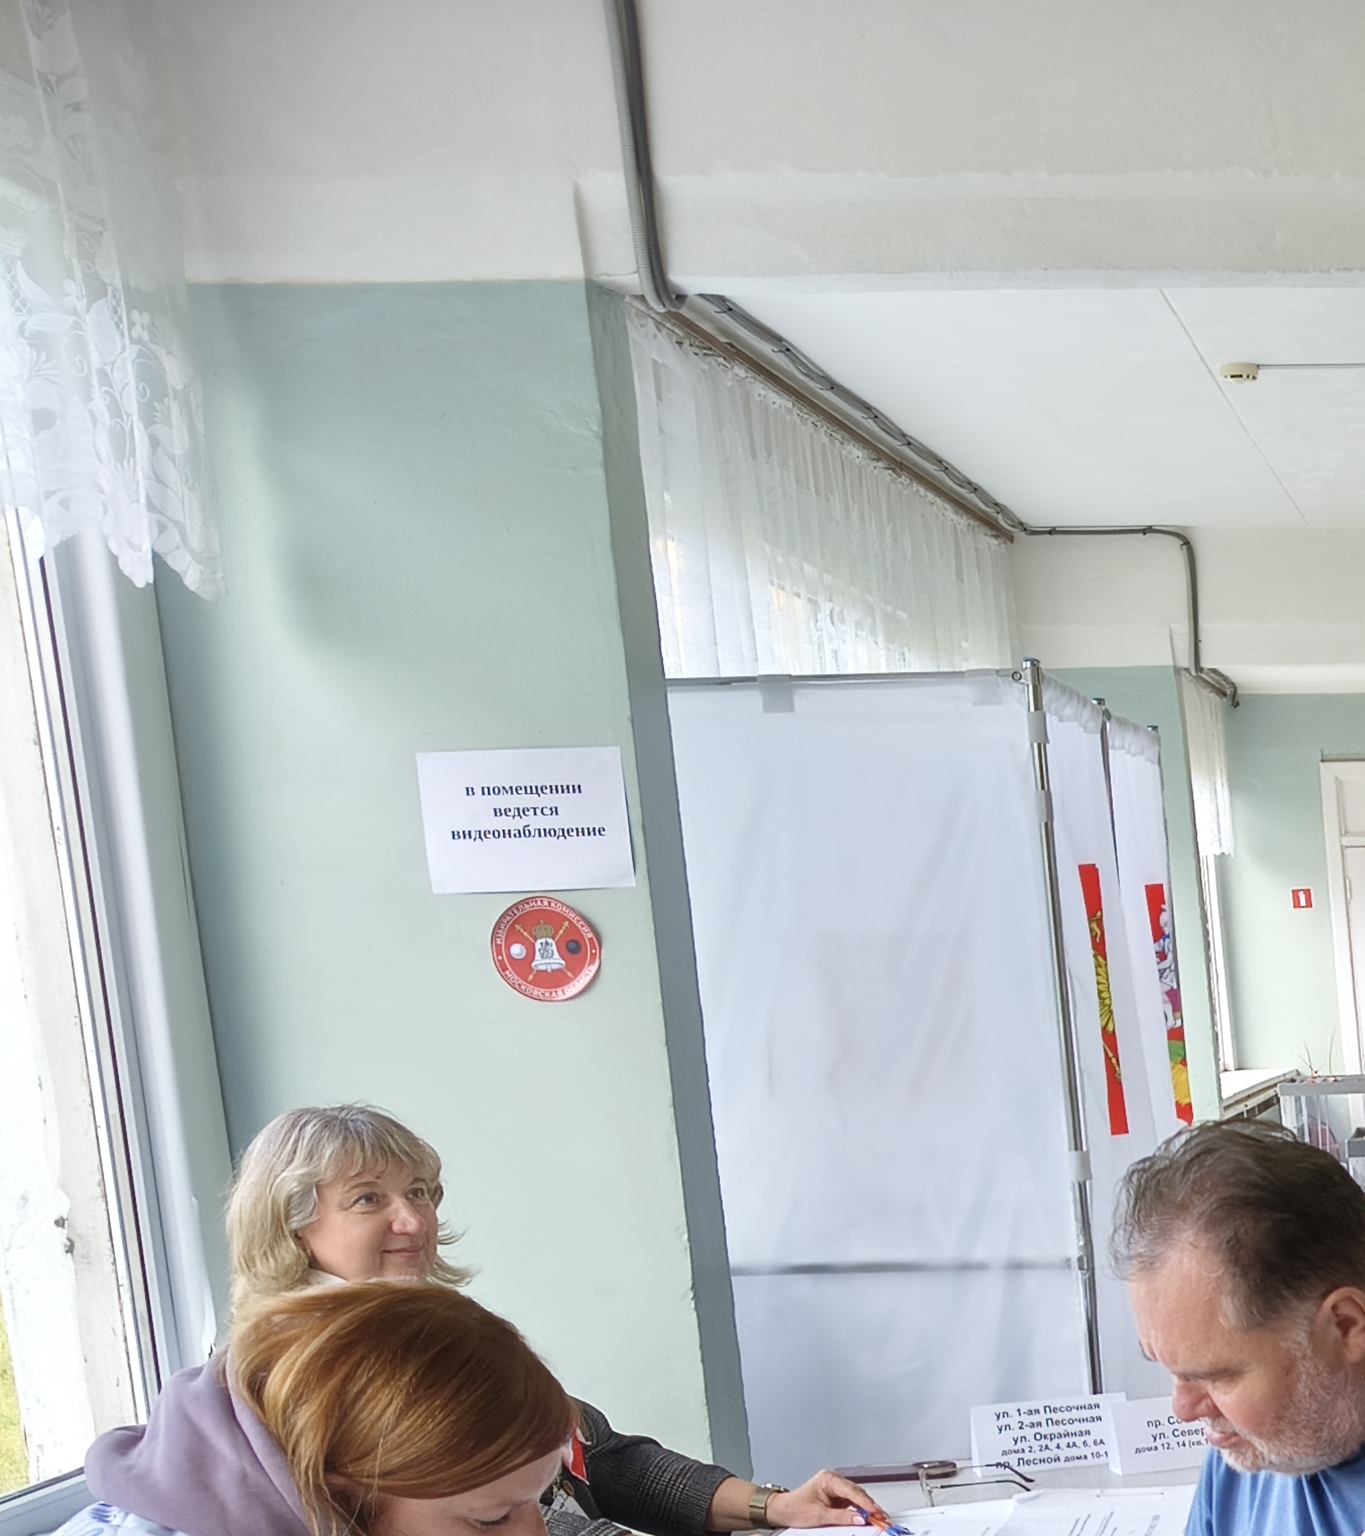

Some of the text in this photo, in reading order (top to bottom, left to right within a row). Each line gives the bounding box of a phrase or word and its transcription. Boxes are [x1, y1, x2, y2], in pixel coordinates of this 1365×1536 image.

[465, 783, 582, 797] в помещении
[493, 804, 559, 819] ведется
[451, 824, 606, 842] видеонаблюдение
[550, 900, 593, 939] КОМИССИЯ
[994, 1402, 1100, 1421] ул. 1-ая Песочная
[996, 1415, 1102, 1433] ул. 2-ая Песочная
[1147, 1419, 1164, 1428] пр.
[1012, 1428, 1091, 1446] ул. Окрайная
[1151, 1432, 1169, 1442] ул.
[1001, 1447, 1026, 1456] дома
[1134, 1446, 1159, 1454] дома
[1176, 1440, 1186, 1448] 14
[1017, 1454, 1061, 1468] Лесной
[1064, 1454, 1088, 1463] дома
